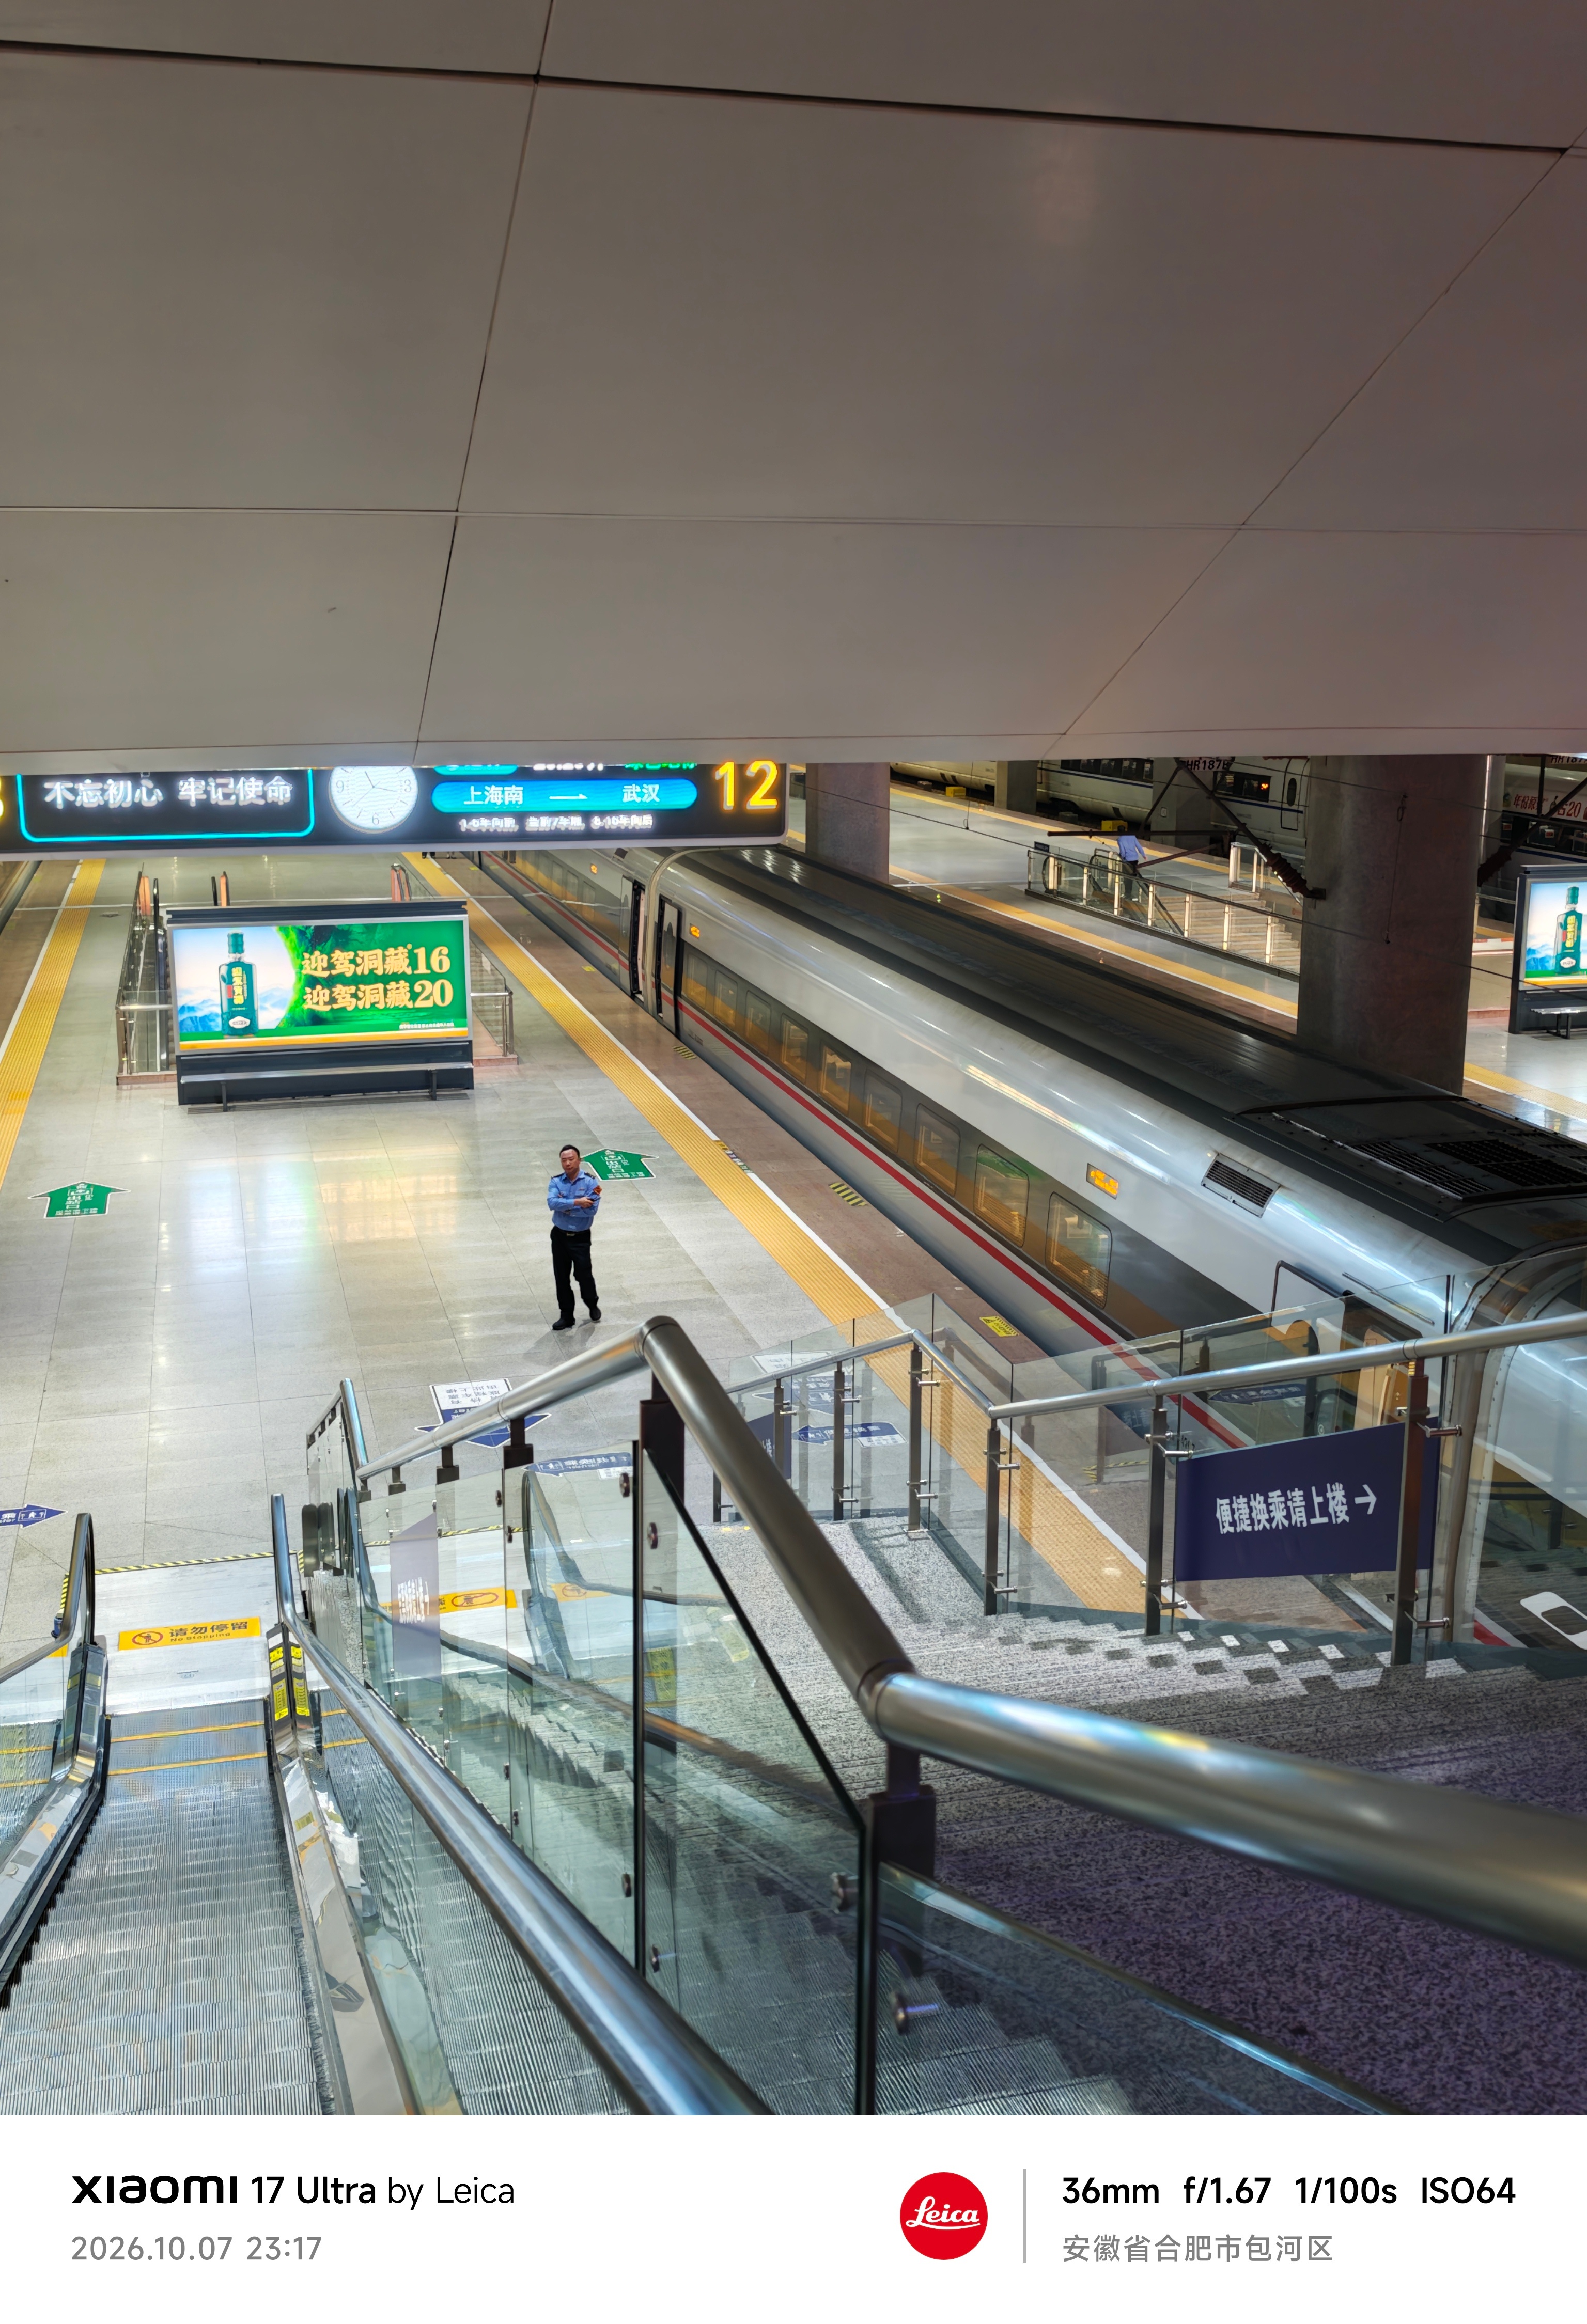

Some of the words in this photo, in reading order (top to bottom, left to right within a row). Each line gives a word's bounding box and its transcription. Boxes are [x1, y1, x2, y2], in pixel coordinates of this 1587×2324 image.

[44, 779, 164, 809] 不忘初心
[178, 776, 293, 807] 牢记使命
[463, 784, 524, 805] 上海南
[622, 783, 661, 803] 武汉
[715, 761, 777, 810] 12
[303, 979, 454, 1011] 迎驾洞藏20
[1216, 1482, 1349, 1534] 便捷换乘请上楼
[169, 1621, 248, 1638] 请勿停留
[186, 1632, 231, 1641] Stopping
